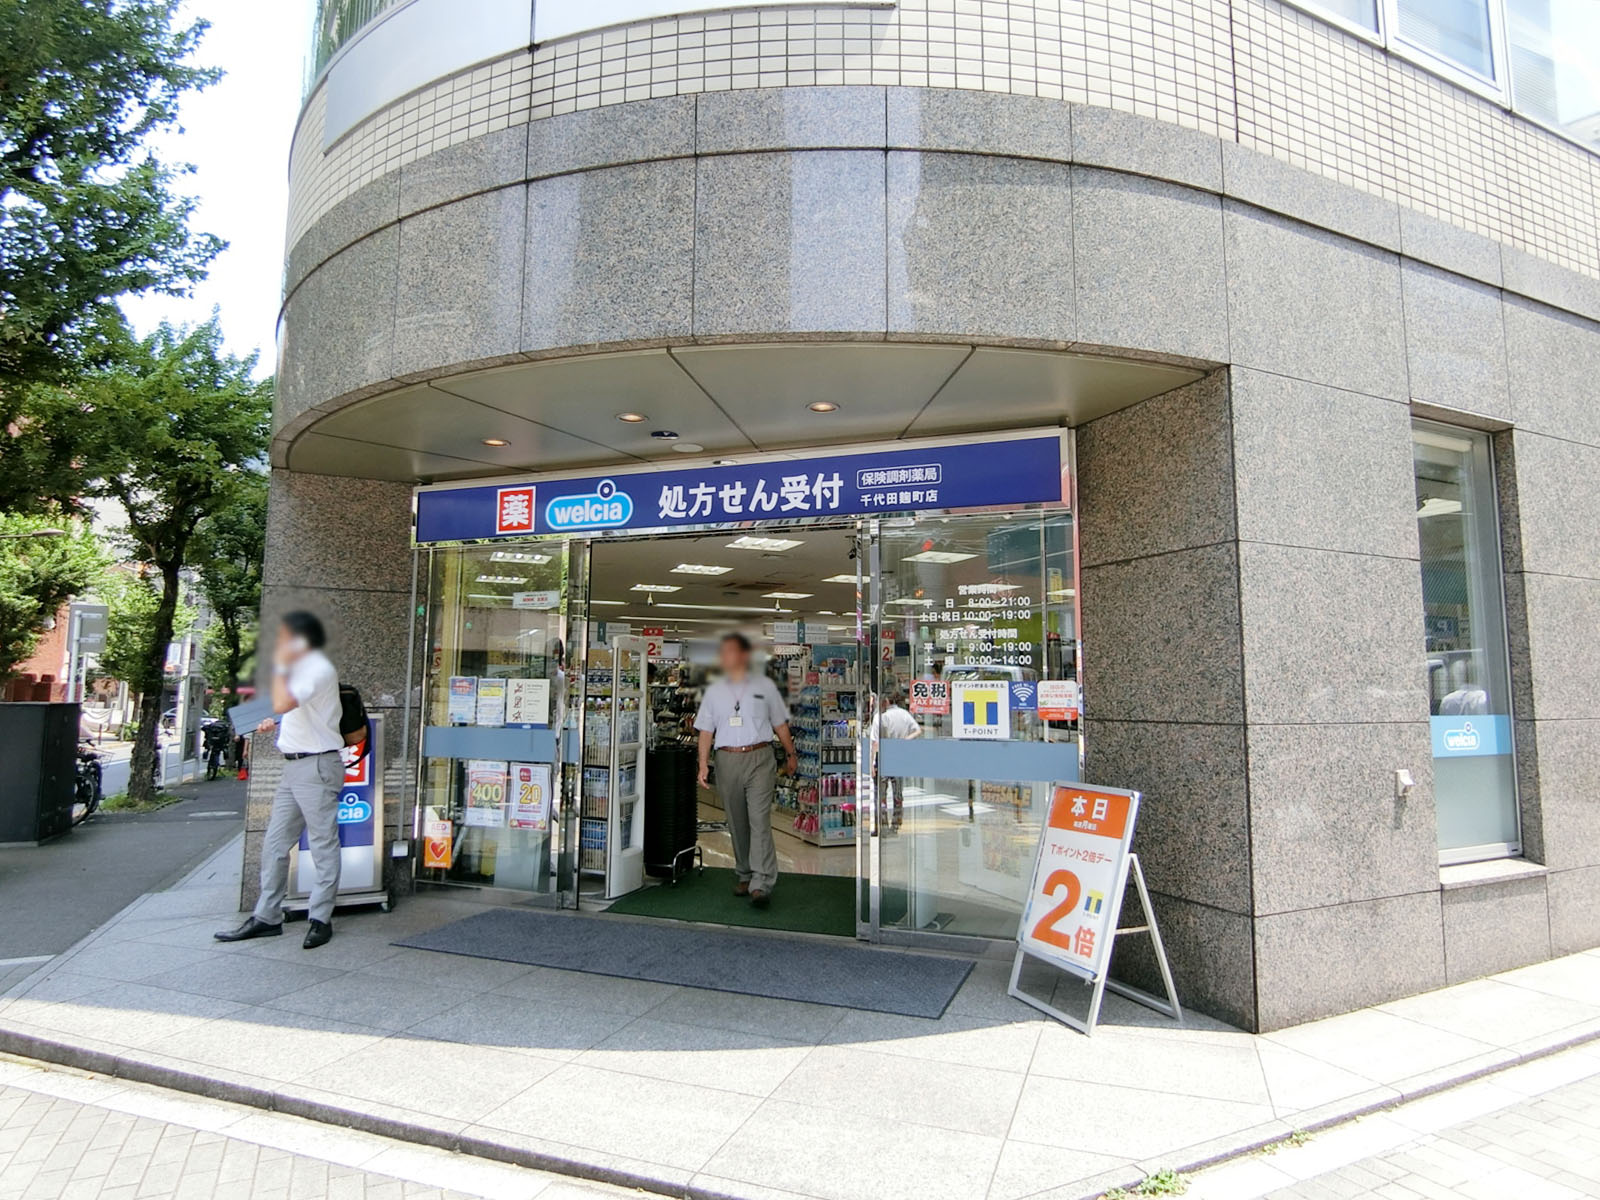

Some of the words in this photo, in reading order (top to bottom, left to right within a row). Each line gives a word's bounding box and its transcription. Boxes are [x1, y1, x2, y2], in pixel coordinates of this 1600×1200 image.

[861, 467, 937, 486] 保険調剤薬局
[658, 472, 844, 519] 処方せん受付
[502, 493, 530, 527] 薬
[554, 499, 623, 525] welcia
[958, 584, 998, 596] 営業時間
[945, 598, 954, 608] 日
[940, 628, 1018, 640] 処方せん受付時間
[923, 642, 934, 653] 平
[945, 642, 955, 653] 日
[924, 656, 934, 666] 土
[913, 682, 947, 698] 免税
[963, 728, 999, 736] T-POINT
[472, 783, 502, 802] 400
[520, 783, 542, 805] 20
[338, 806, 364, 820] cia
[1071, 795, 1109, 821] 本日
[1051, 843, 1113, 864] Tポイント2倍デー
